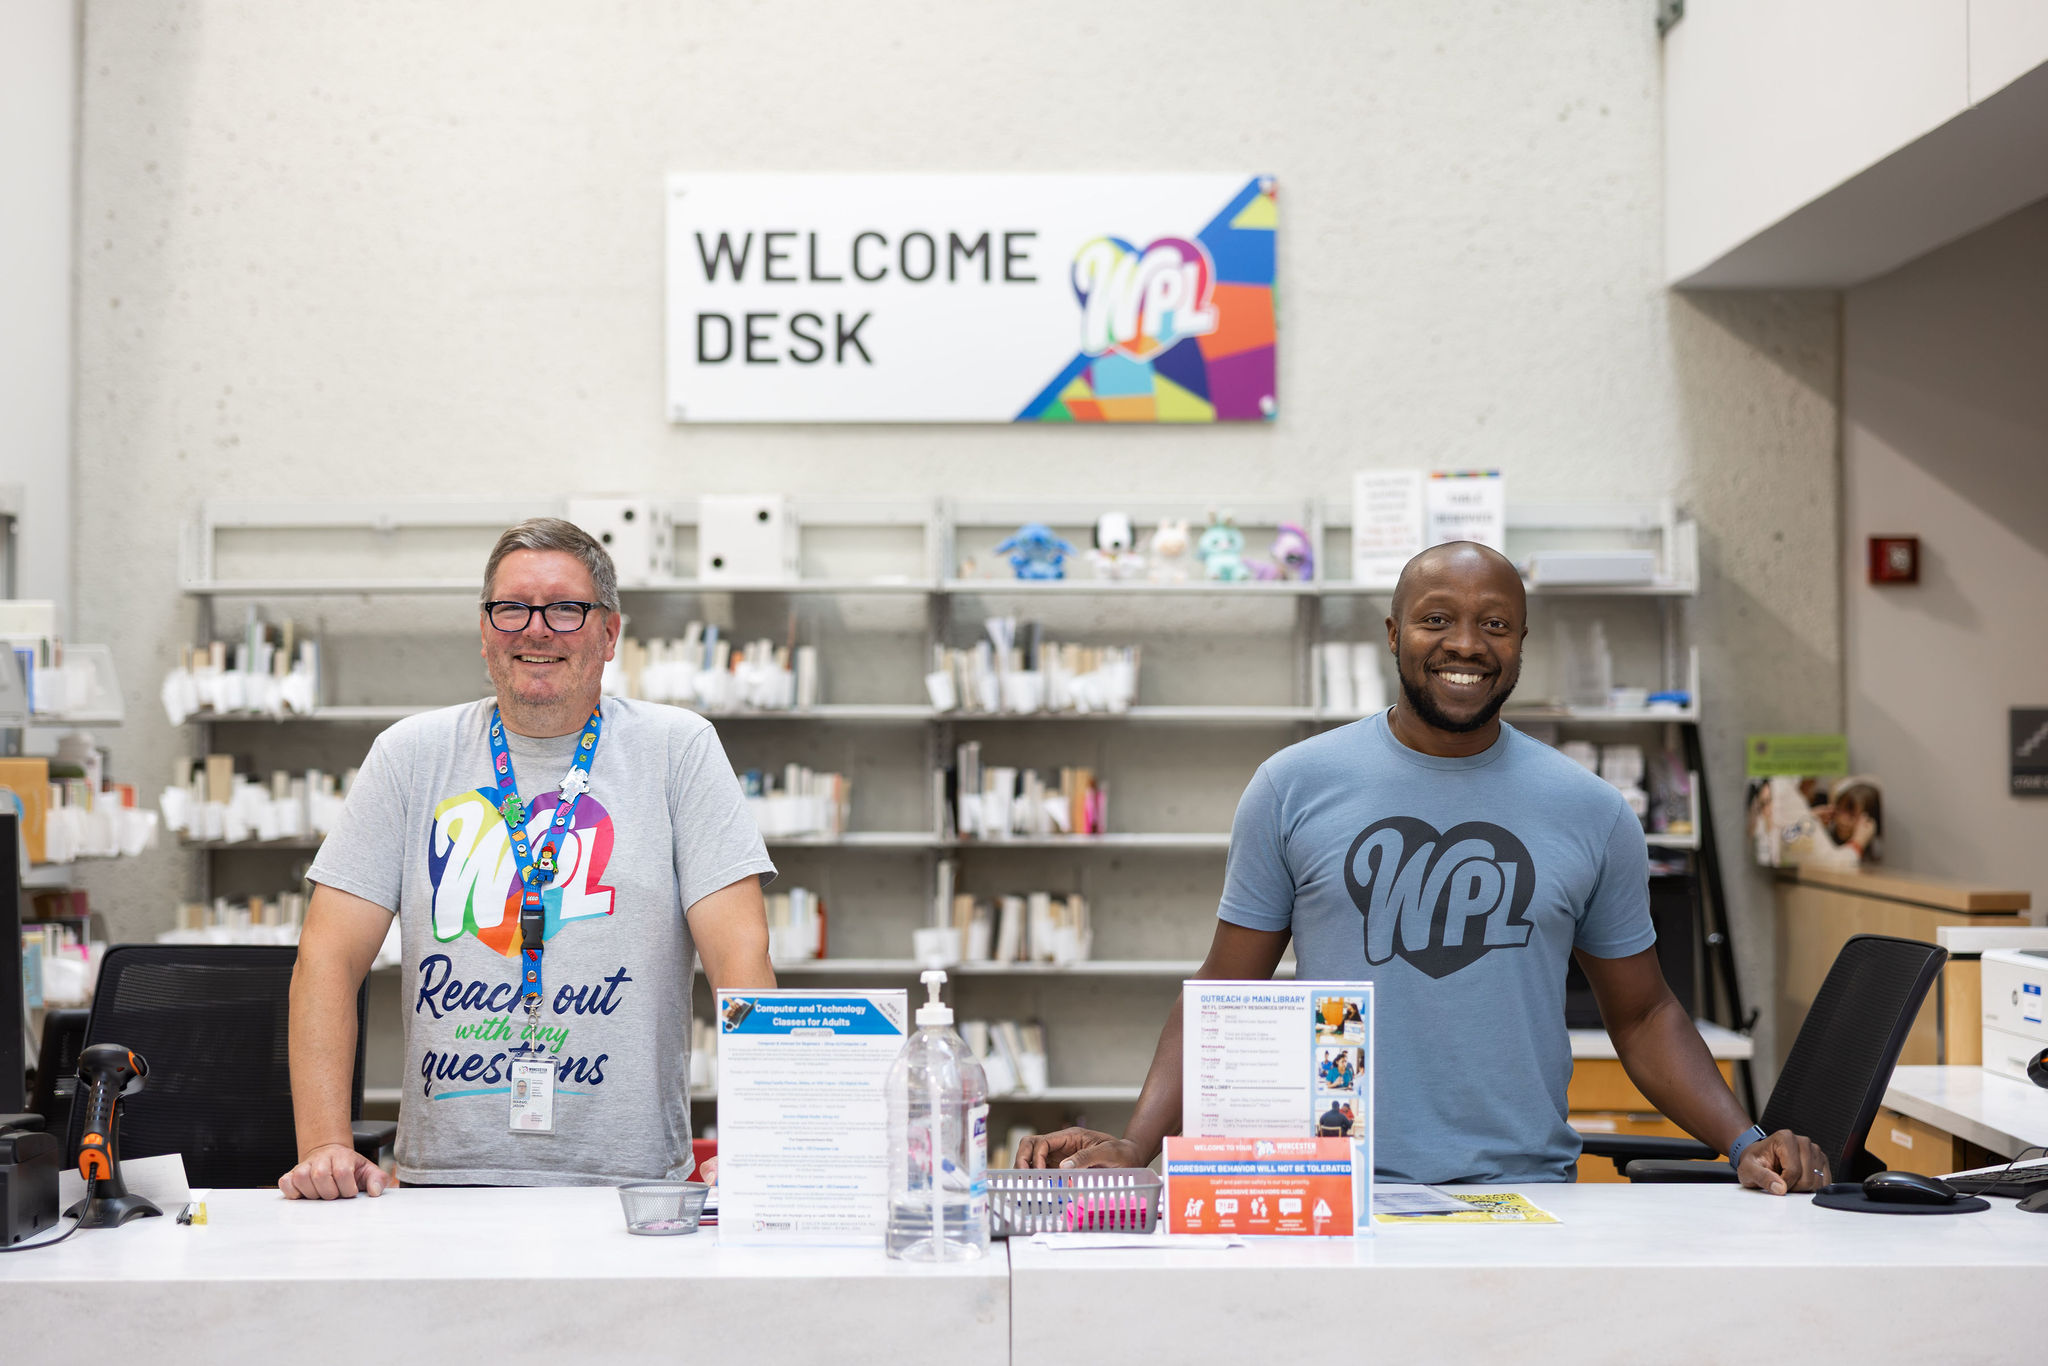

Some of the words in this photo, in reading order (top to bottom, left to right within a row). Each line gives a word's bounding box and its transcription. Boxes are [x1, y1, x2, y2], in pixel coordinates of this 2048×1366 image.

[695, 231, 1039, 283] WELCOME
[1074, 241, 1219, 355] WPL
[697, 312, 874, 364] DESK
[1352, 827, 1531, 963] WPL
[553, 966, 633, 1015] out
[1201, 995, 1241, 1003] OUTREACH
[1252, 995, 1271, 1003] MAIN
[1273, 995, 1305, 1003] LIBRARY
[755, 1004, 798, 1014] Computer
[799, 1004, 815, 1013] and
[816, 1004, 866, 1015] Technology
[772, 1017, 806, 1027] Classes
[807, 1017, 820, 1027] for
[822, 1017, 851, 1027] Adults
[455, 1015, 513, 1041] with
[520, 1022, 570, 1054] any
[1277, 1142, 1316, 1150] WORCESTER
[1168, 1164, 1216, 1173] AGGRESSIVE
[1217, 1164, 1256, 1173] BEHAVIOR
[1256, 1164, 1276, 1173] WILL
[1277, 1164, 1293, 1173] NOT
[1295, 1164, 1305, 1173] BE
[1306, 1164, 1351, 1173] TOLERATED
[1210, 1178, 1223, 1186] Staff
[1223, 1178, 1232, 1186] and
